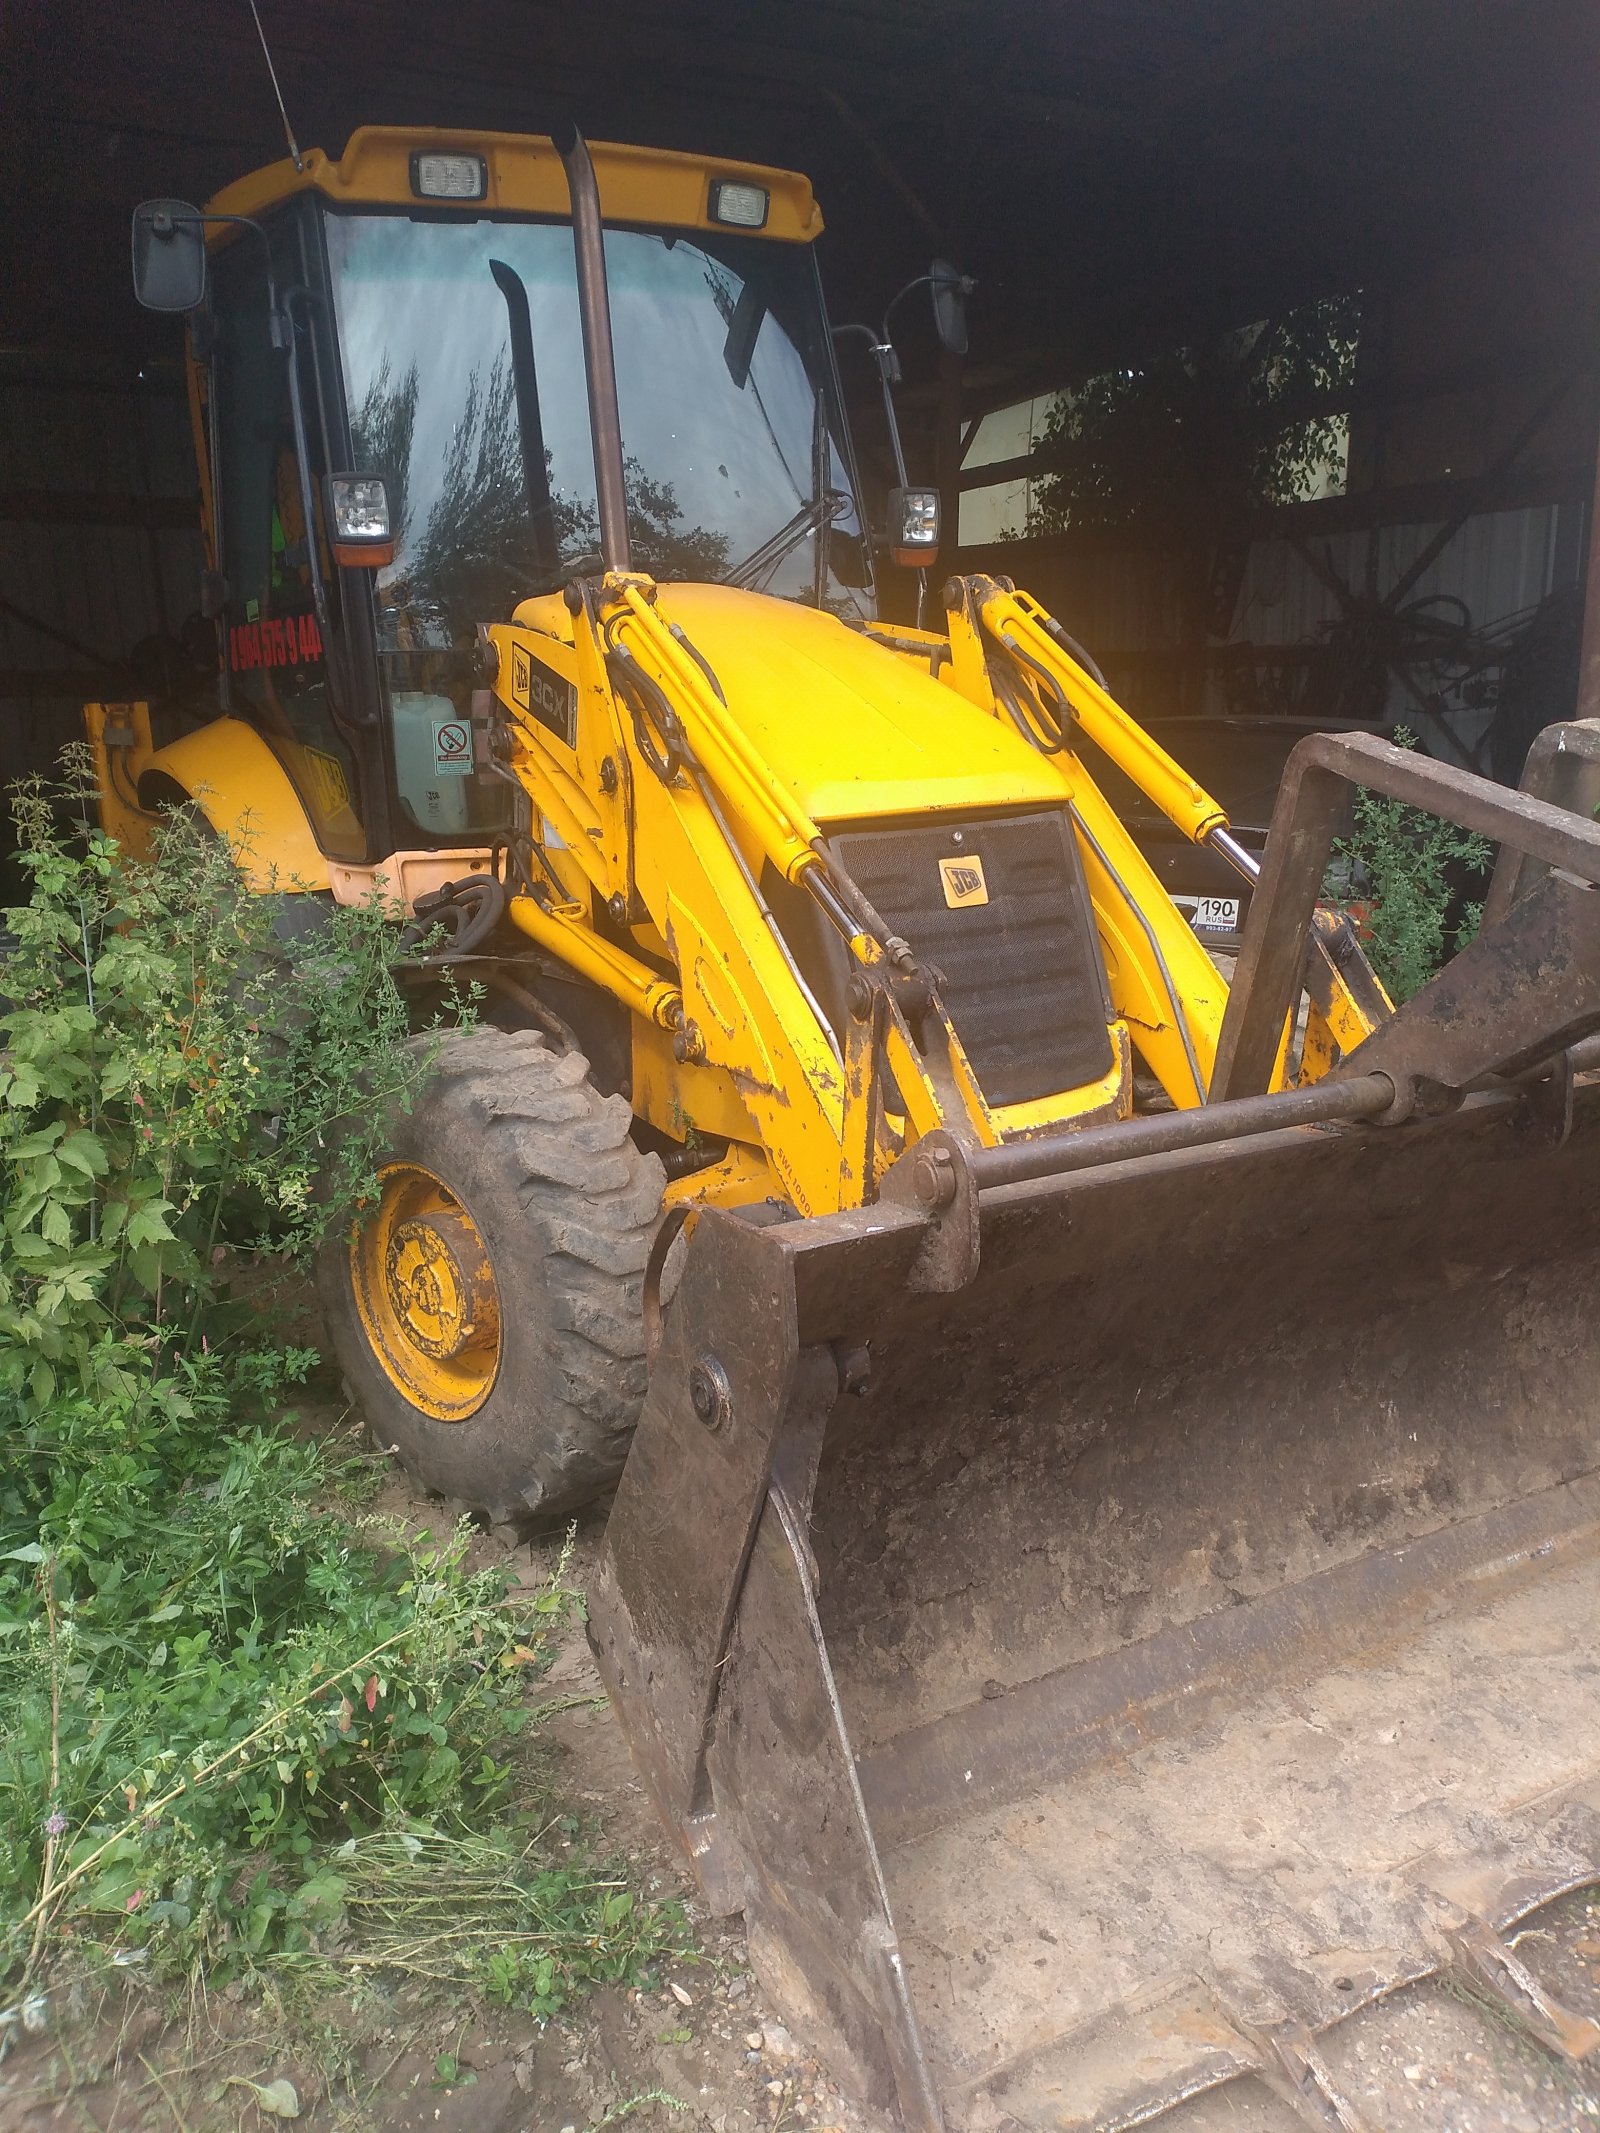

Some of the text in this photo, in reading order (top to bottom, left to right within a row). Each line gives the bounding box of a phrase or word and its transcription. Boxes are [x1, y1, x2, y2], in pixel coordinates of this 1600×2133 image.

[261, 619, 286, 666] 575
[285, 617, 298, 665] 9
[516, 660, 529, 689] JCB
[531, 675, 565, 723] 3CX
[312, 754, 347, 812] JCB
[951, 870, 979, 894] JCB
[1201, 899, 1233, 917] 190
[1206, 916, 1223, 924] RUS
[777, 1147, 792, 1179] SWL
